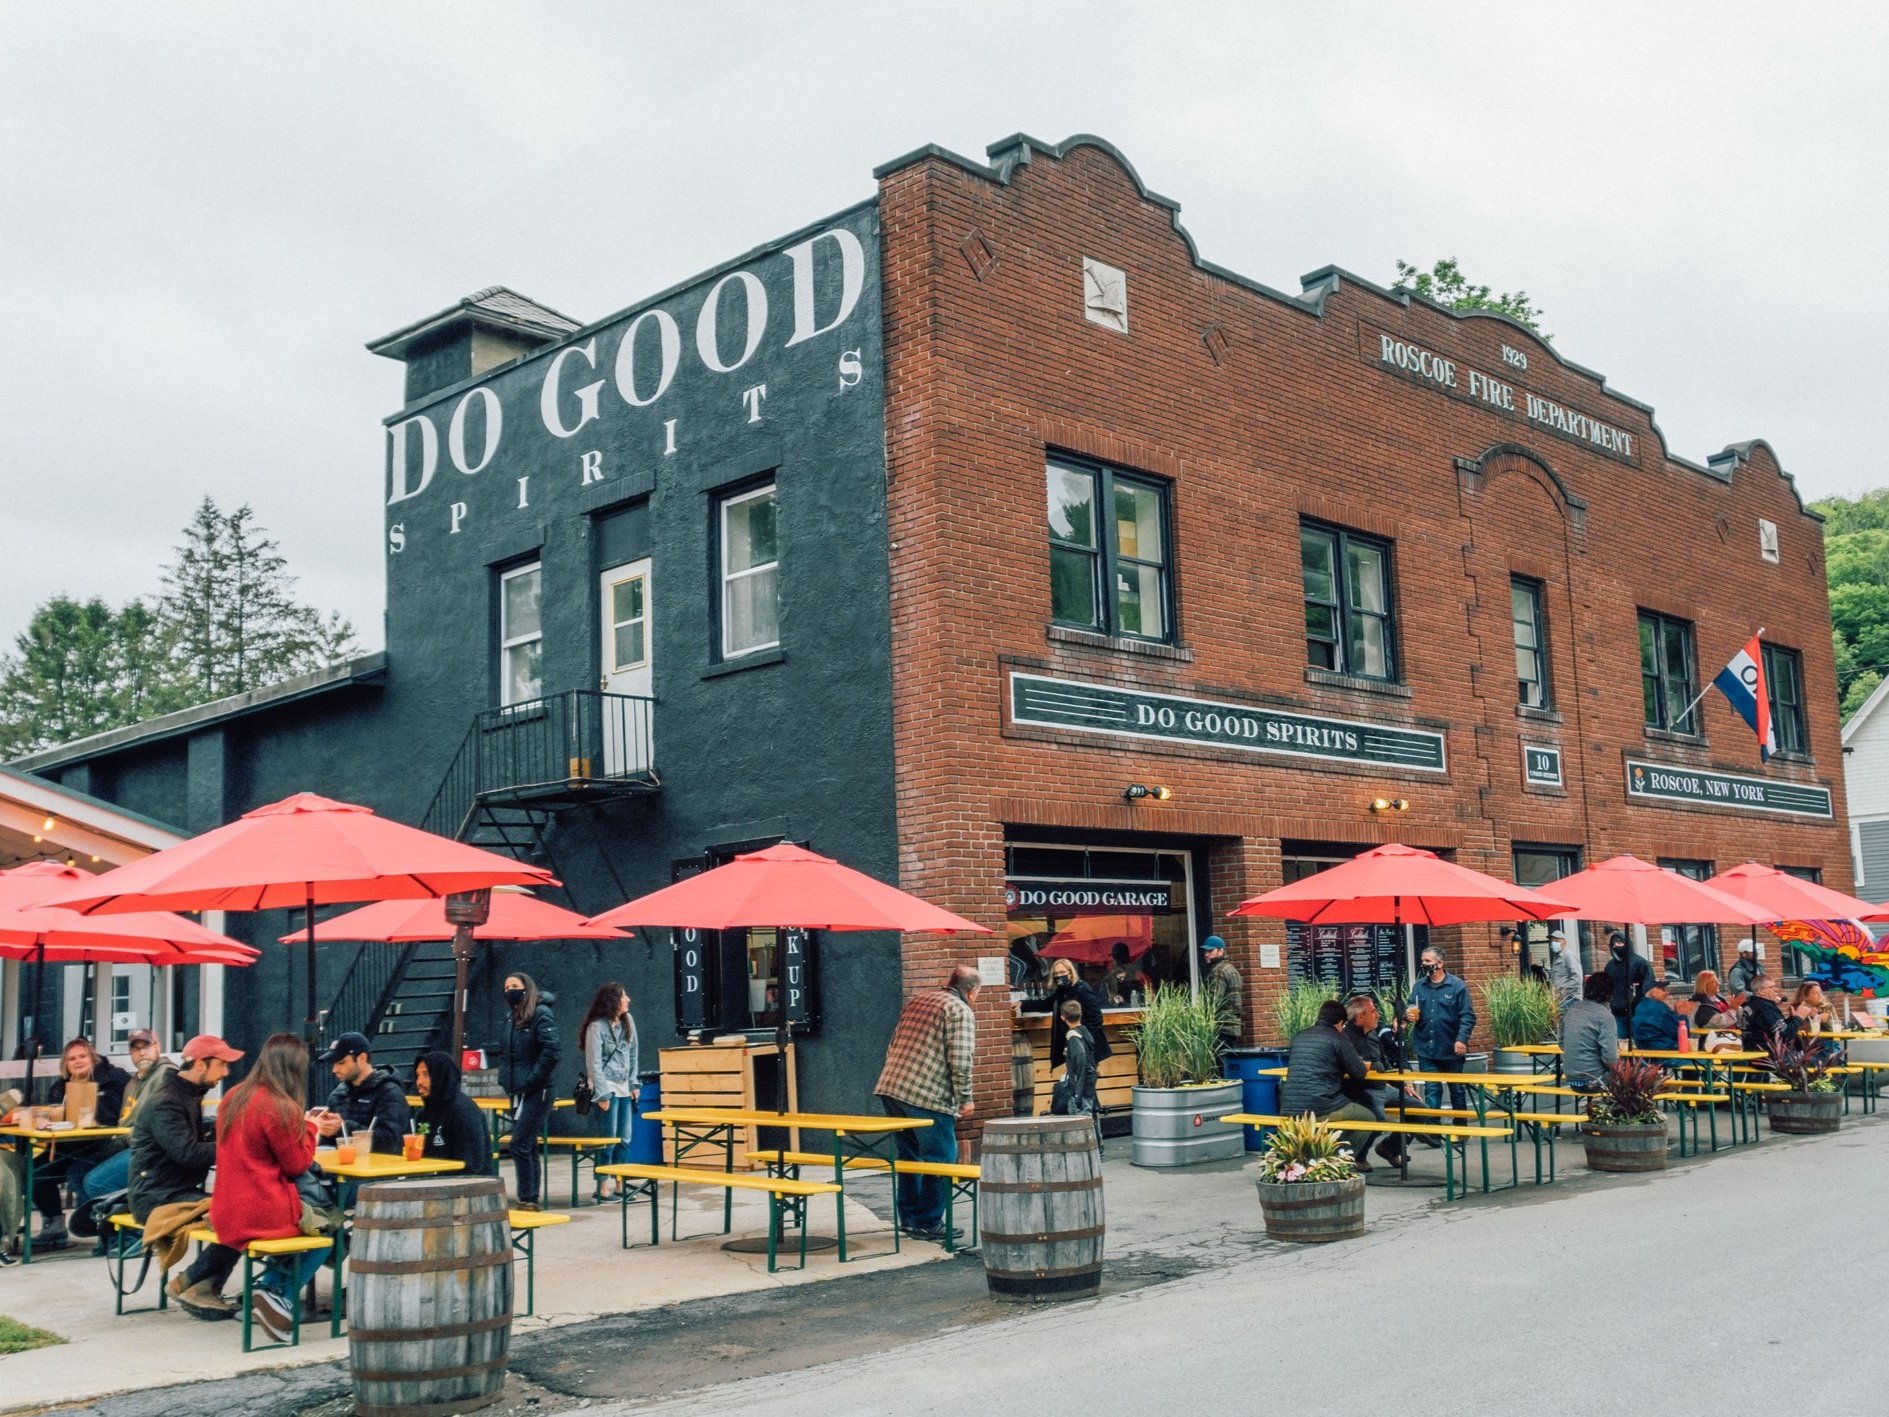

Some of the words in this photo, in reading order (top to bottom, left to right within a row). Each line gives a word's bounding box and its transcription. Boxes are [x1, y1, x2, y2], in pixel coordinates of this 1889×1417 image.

[387, 387, 501, 505] DO
[541, 229, 865, 437] GOOD
[1502, 344, 1528, 369] 1929
[1380, 334, 1457, 387] ROSCOE
[1468, 370, 1514, 411] FIRE
[1525, 393, 1632, 456] DEPARTMENT
[389, 348, 863, 554] SPIRITS
[1137, 704, 1175, 728] DO
[1185, 713, 1258, 738] GOOD
[1267, 721, 1358, 751] SPIRITS
[1536, 755, 1549, 770] 10
[1650, 772, 1703, 796] ROSCOE,
[1706, 780, 1730, 797] NEW
[1733, 784, 1765, 801] YORK
[1020, 890, 1046, 906] DO
[1050, 891, 1100, 906] GOOD
[1102, 892, 1167, 906] GARAGE
[685, 928, 698, 992] OOD
